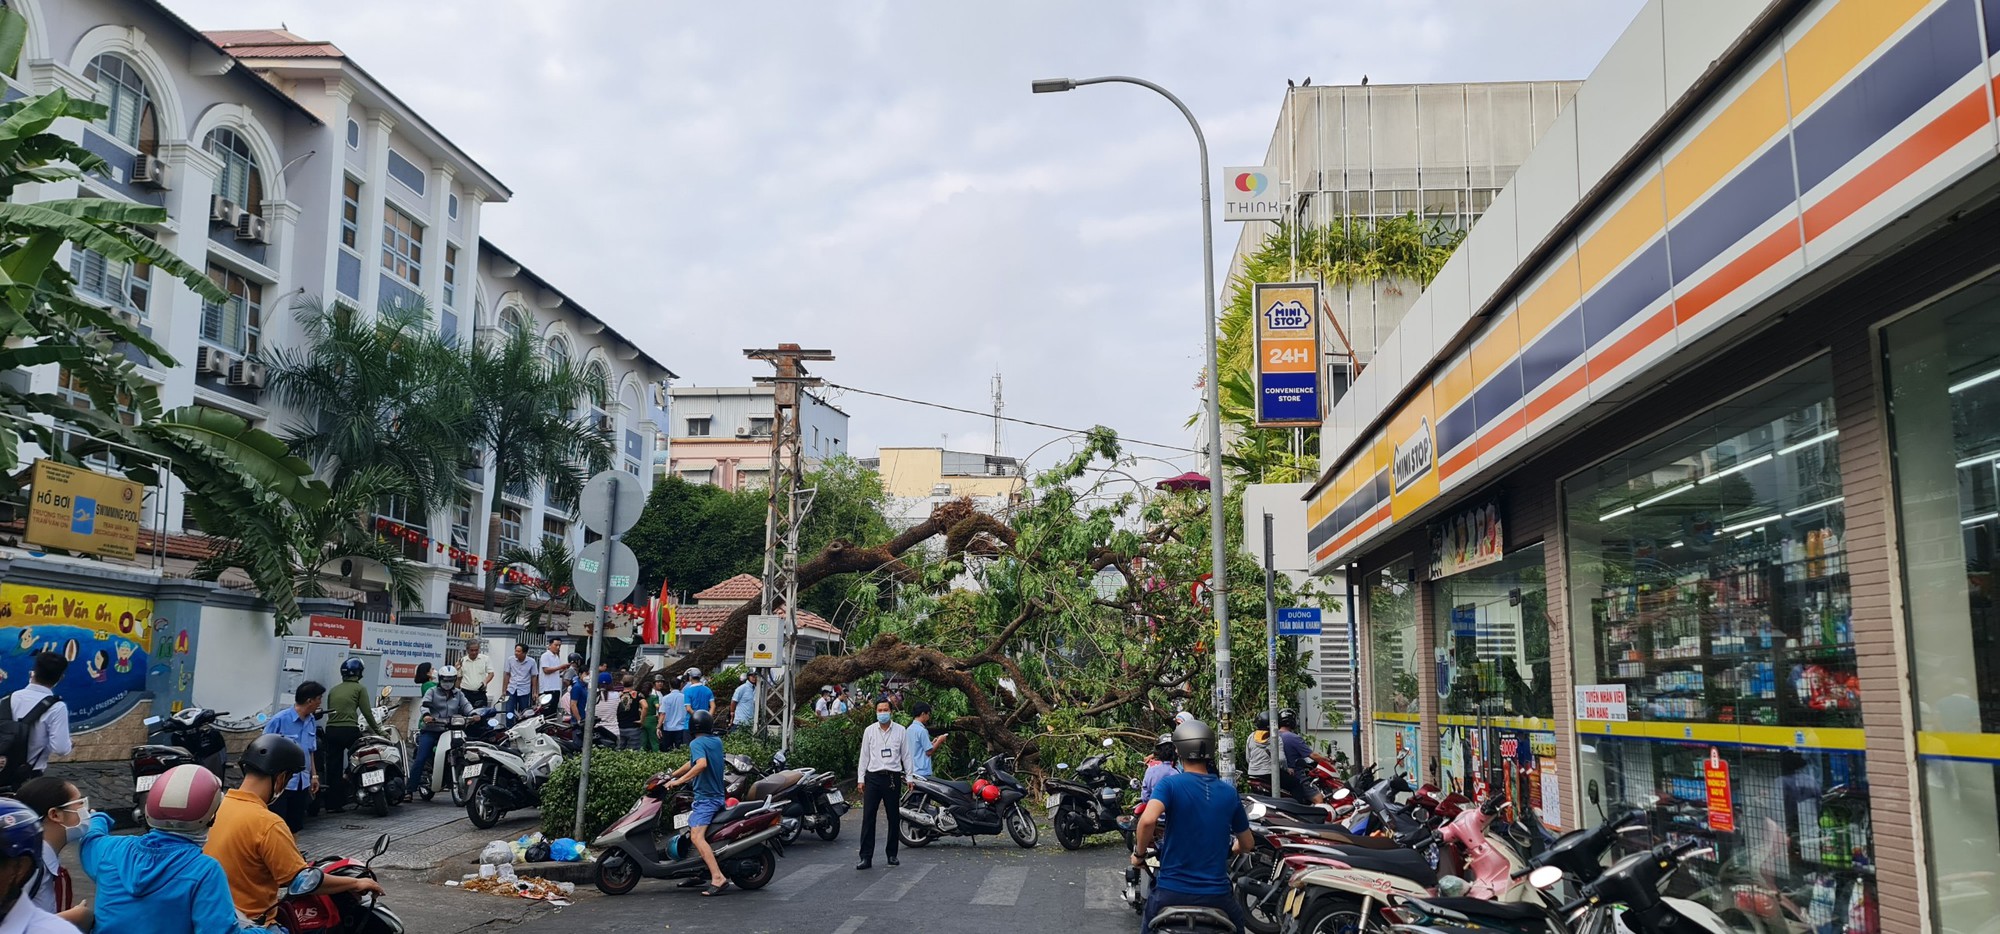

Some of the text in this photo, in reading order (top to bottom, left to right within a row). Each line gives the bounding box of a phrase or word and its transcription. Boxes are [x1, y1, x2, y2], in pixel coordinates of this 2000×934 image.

[1226, 201, 1279, 214] THINK
[1275, 308, 1301, 317] MINI
[1274, 317, 1302, 326] STOP
[1269, 348, 1309, 364] 24H
[1396, 437, 1429, 484] MINI STOP
[53, 494, 71, 509] BƠI
[96, 503, 138, 523] SWIMMING POOL
[62, 597, 89, 619] Văn
[1287, 610, 1312, 619] ĐƯỜNG
